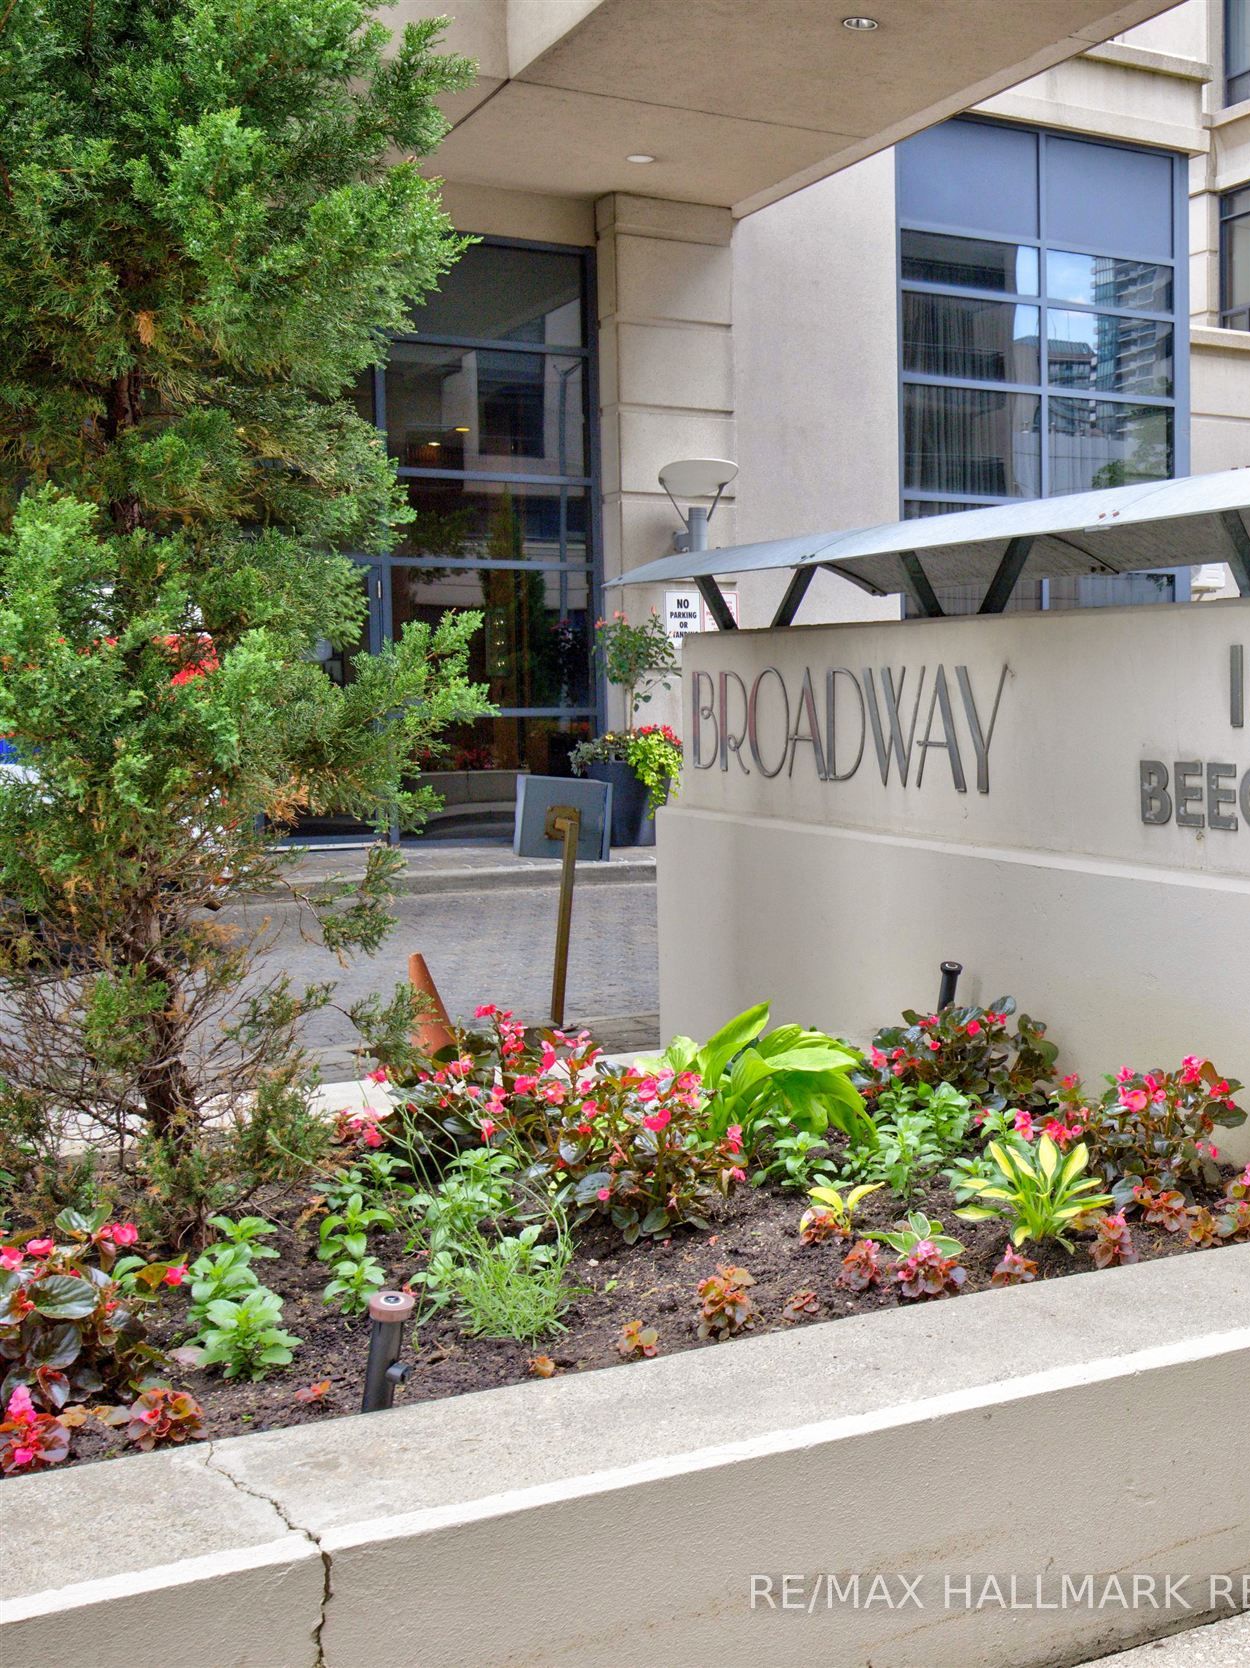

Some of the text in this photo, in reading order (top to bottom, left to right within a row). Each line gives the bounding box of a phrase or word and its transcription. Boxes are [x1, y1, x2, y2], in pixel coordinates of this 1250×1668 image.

[676, 599, 690, 609] NO
[669, 611, 697, 619] PARKING
[679, 621, 689, 629] OR
[691, 663, 1008, 794] BROADWAY
